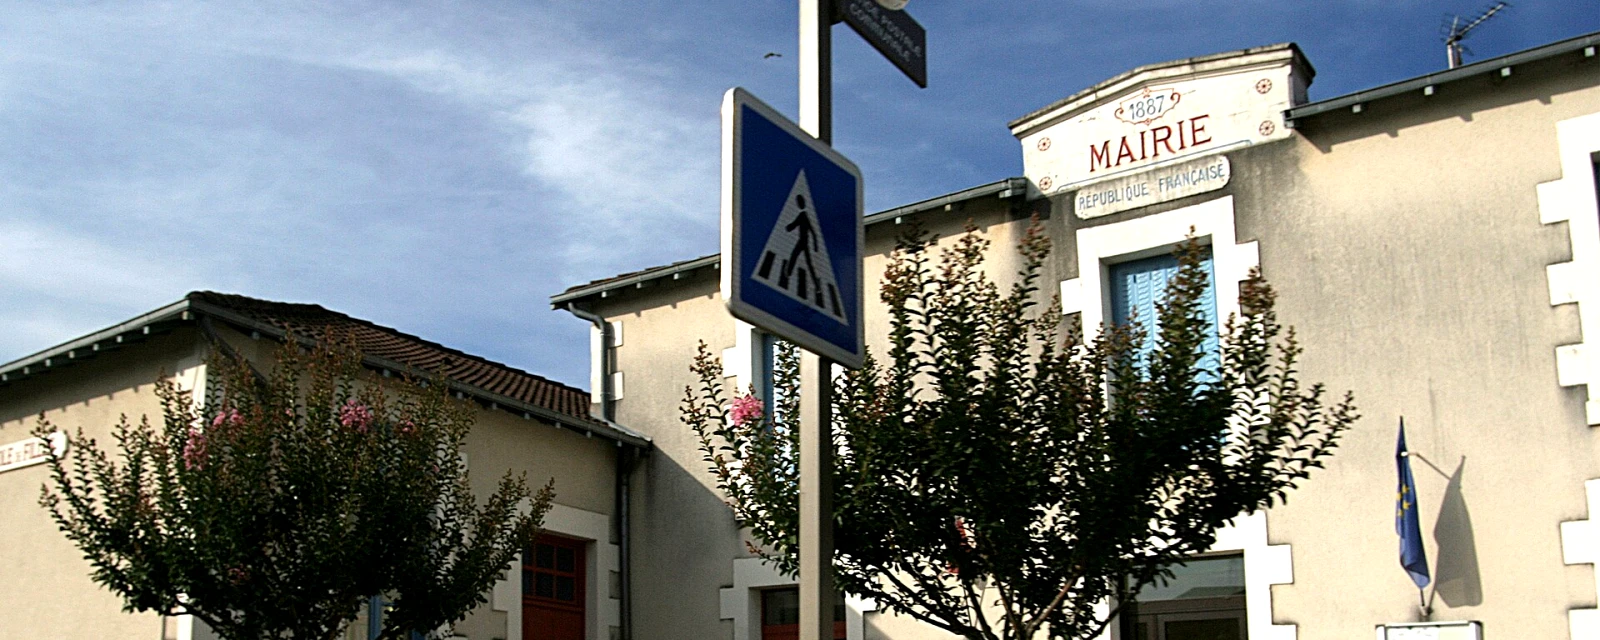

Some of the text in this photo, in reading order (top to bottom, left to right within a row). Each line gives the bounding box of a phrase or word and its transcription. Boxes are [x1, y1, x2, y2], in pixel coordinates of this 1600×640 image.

[1128, 95, 1165, 120] 1887
[1089, 114, 1212, 173] MAIRIE
[1158, 163, 1225, 193] FRANÇAISE
